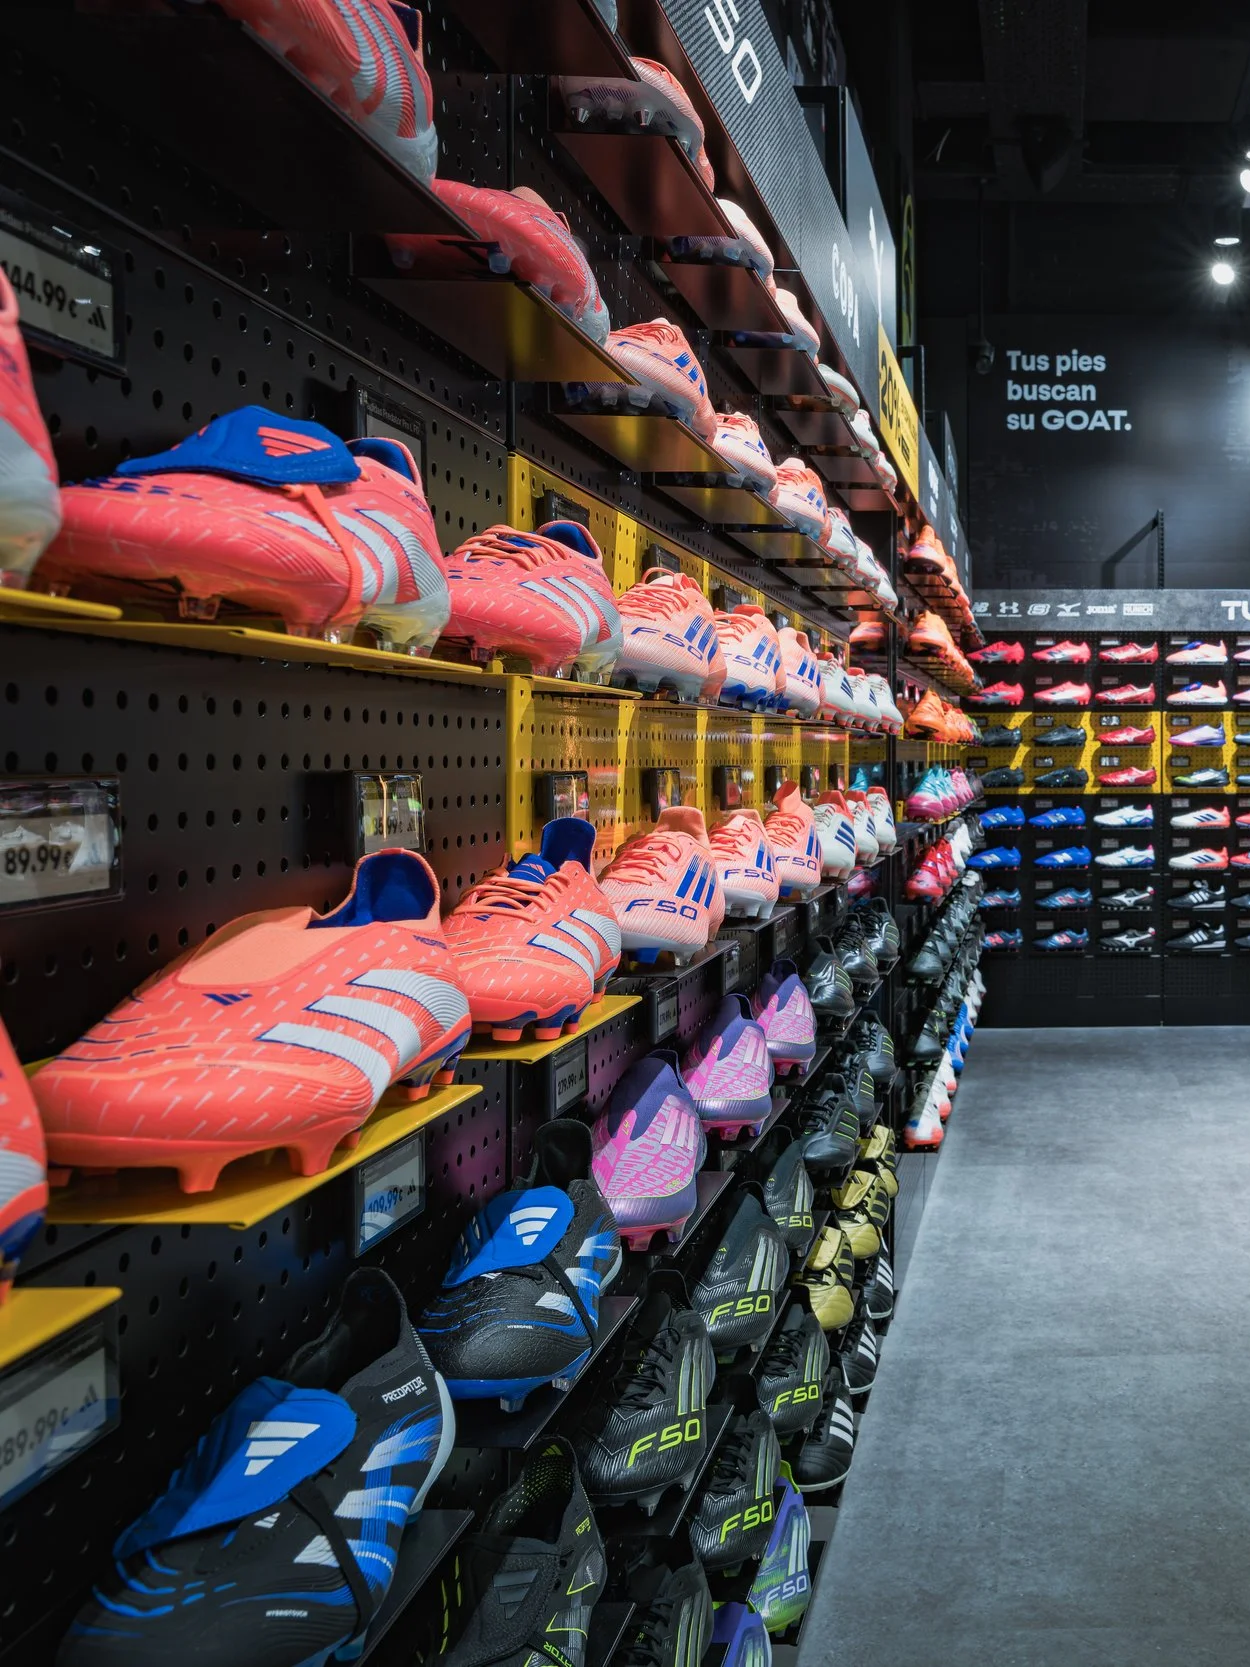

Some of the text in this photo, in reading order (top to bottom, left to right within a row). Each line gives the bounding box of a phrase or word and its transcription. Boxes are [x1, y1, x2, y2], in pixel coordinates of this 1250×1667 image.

[832, 243, 860, 349] COPA
[1006, 348, 1107, 377] Tus pies
[1007, 380, 1097, 401] buscan
[1006, 409, 1133, 431] su GOAT.
[631, 626, 703, 661] F50
[4, 843, 72, 876] 89.99€
[775, 855, 817, 871] F50
[724, 867, 774, 883] F50
[624, 897, 699, 921] F50
[708, 1293, 771, 1326] F50
[381, 1375, 425, 1404] PREDATOR
[773, 1384, 820, 1414] F50
[626, 1418, 701, 1469] F50
[719, 1500, 773, 1544] F50
[764, 1574, 808, 1611] F50
